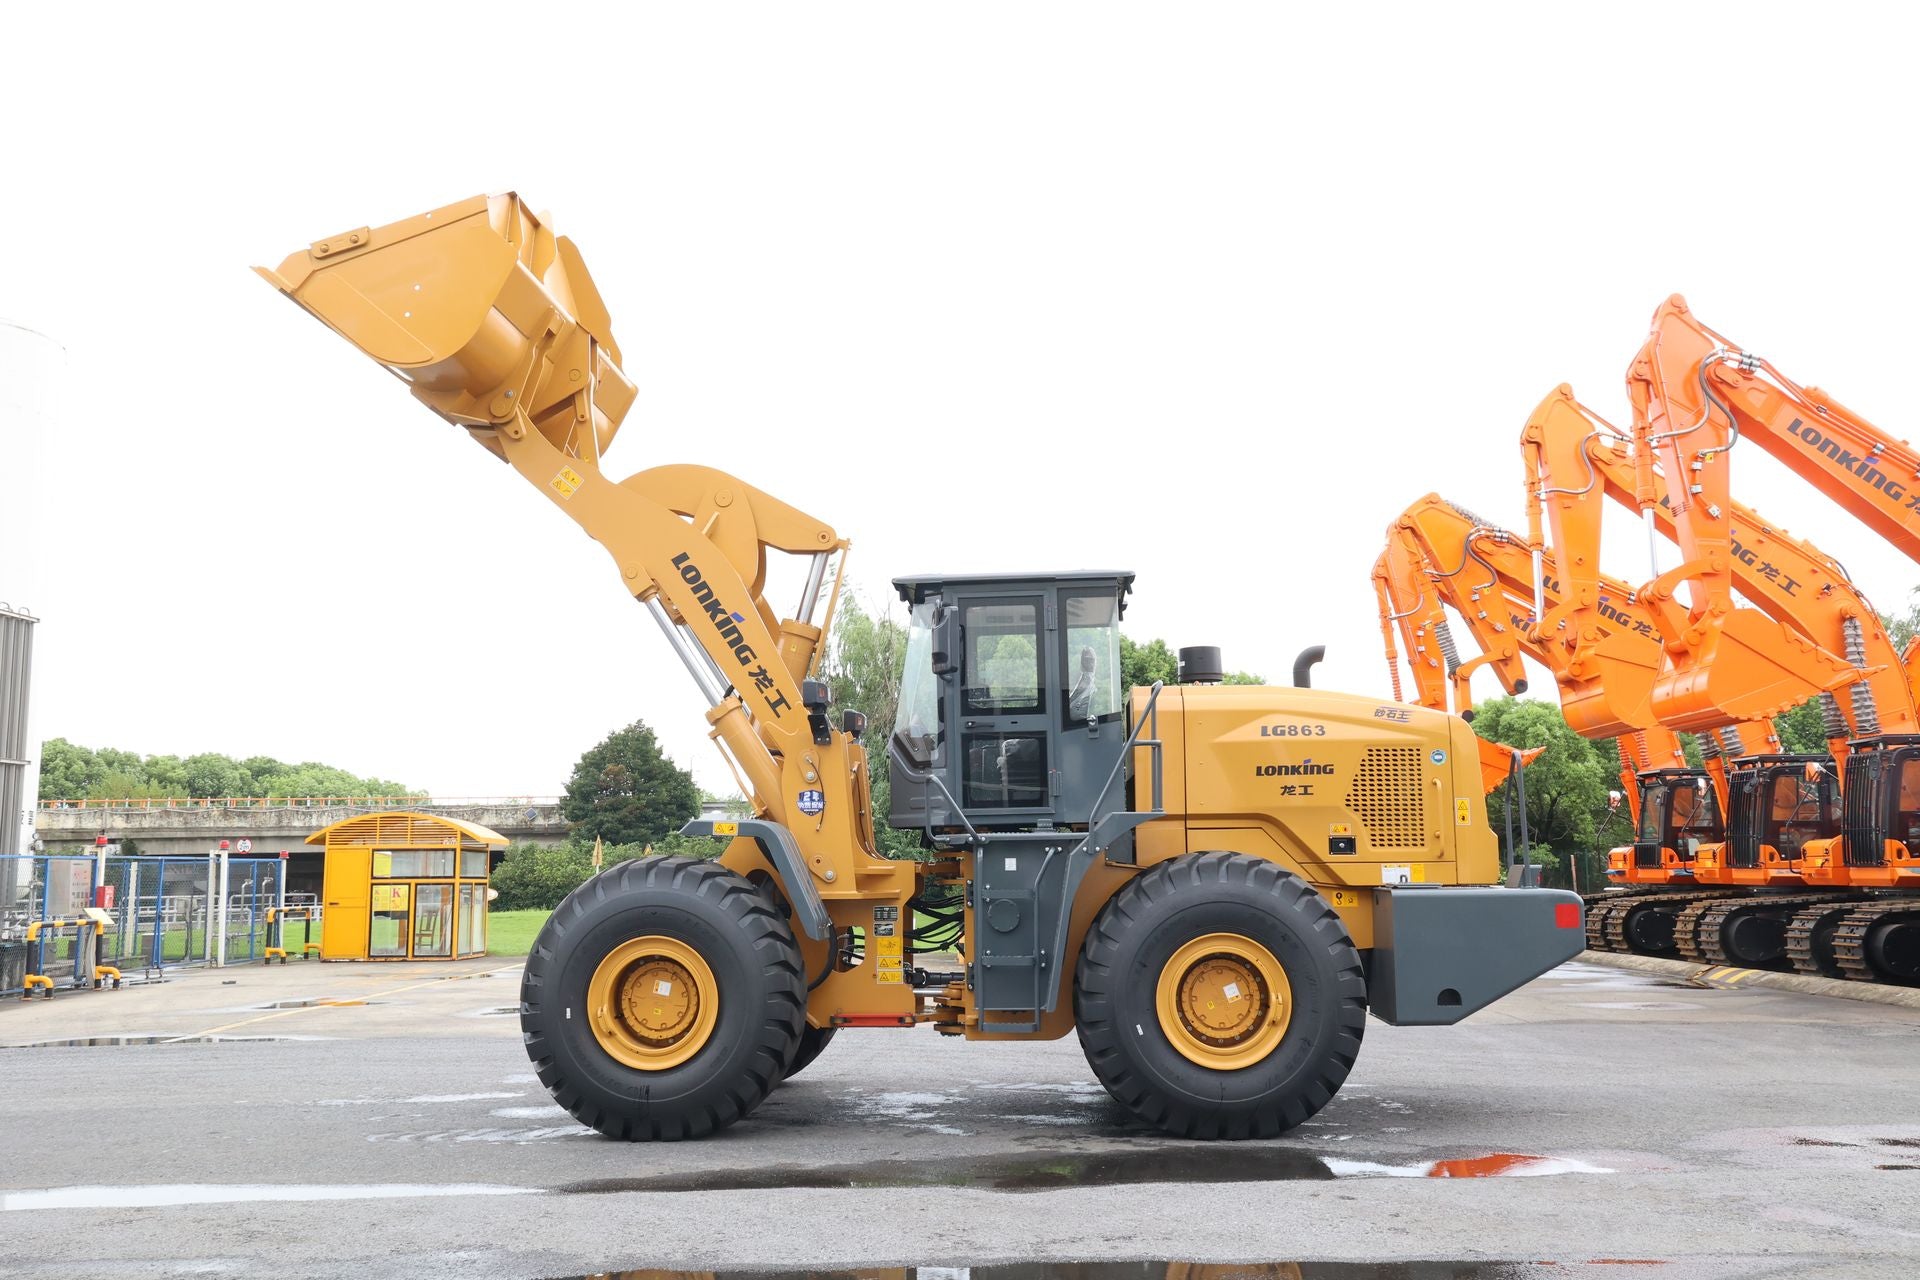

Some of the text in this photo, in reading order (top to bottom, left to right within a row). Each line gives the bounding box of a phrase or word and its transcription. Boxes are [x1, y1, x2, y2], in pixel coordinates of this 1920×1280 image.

[1756, 561, 1802, 597] 龙工
[670, 552, 792, 719] LONKING 龙工
[1374, 708, 1410, 720] 砂石王
[1261, 725, 1326, 737] LG863
[1256, 759, 1334, 777] LONKING
[1280, 785, 1314, 796] 龙工
